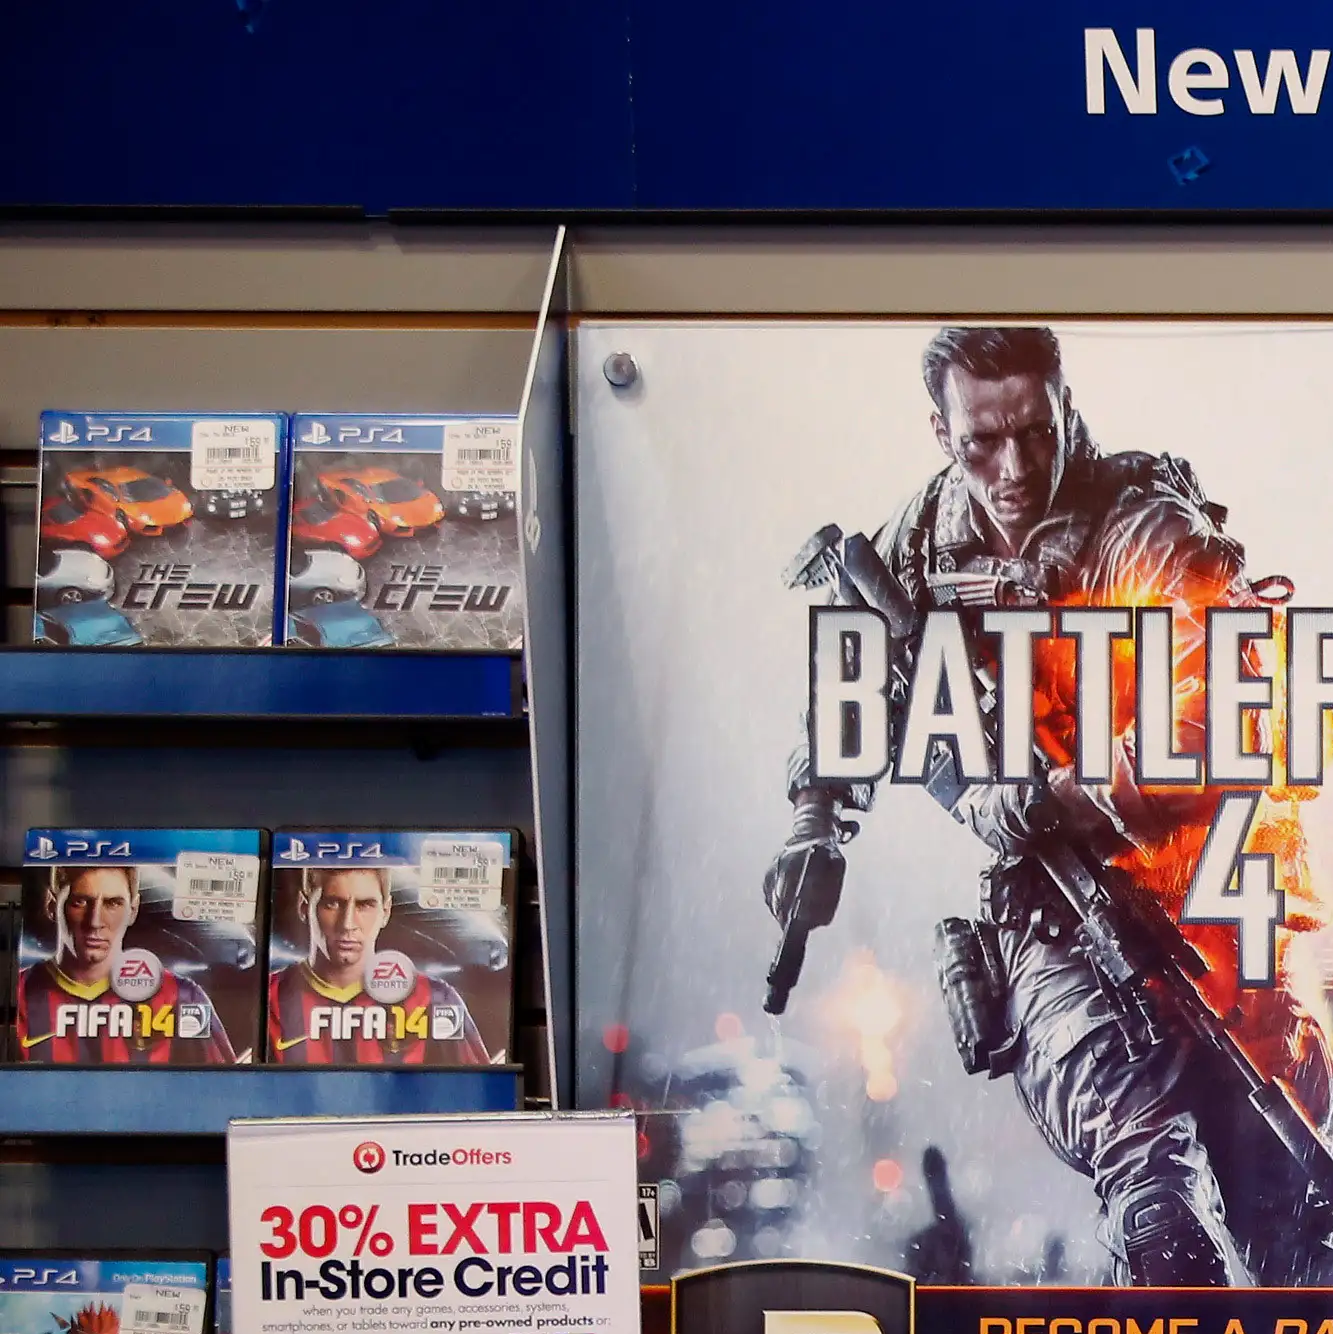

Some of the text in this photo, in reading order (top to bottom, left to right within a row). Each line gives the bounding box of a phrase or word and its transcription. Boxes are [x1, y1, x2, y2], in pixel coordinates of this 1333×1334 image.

[1084, 27, 1331, 116] New
[85, 426, 153, 443] PS4
[137, 564, 195, 582] THE
[1182, 790, 1286, 988] 4
[117, 978, 155, 988] SPORTS
[119, 960, 153, 978] EA
[56, 1004, 175, 1038] FIFA 14
[310, 1006, 428, 1040] FIFA 14
[391, 1148, 512, 1167] TradeOffers
[259, 1200, 610, 1258] 30% EXTRA
[261, 1254, 609, 1301] In-Store Credit
